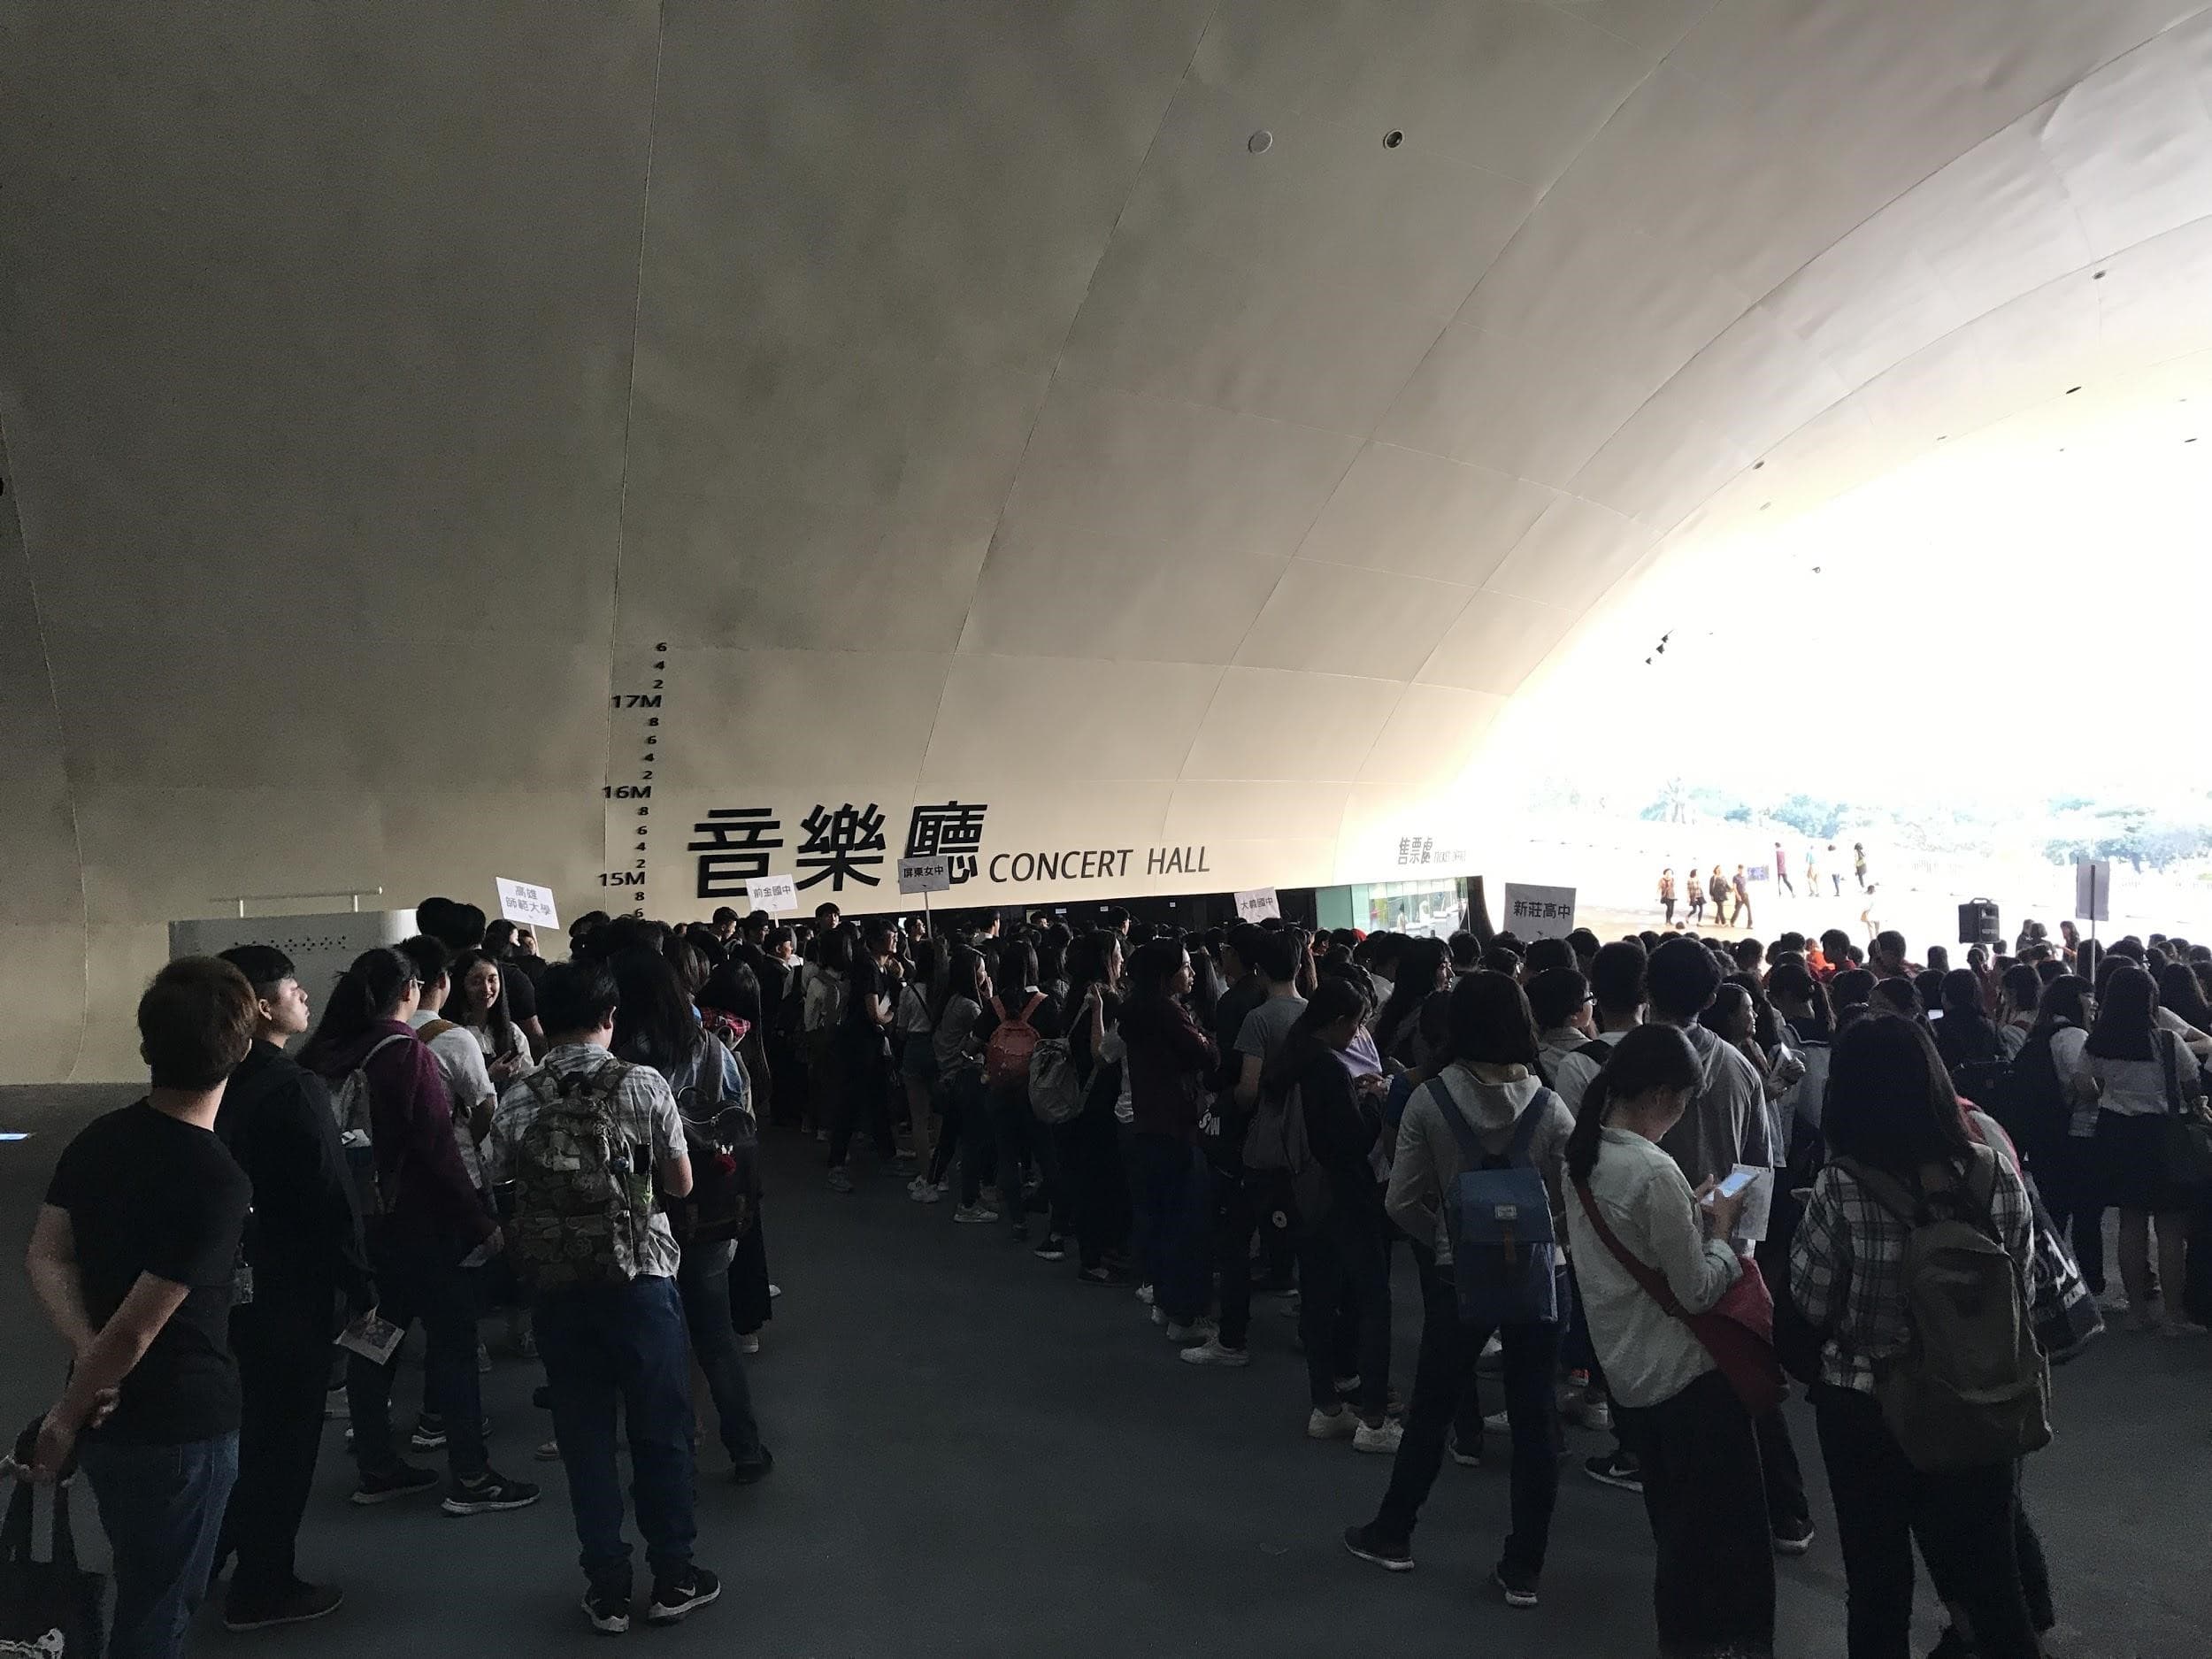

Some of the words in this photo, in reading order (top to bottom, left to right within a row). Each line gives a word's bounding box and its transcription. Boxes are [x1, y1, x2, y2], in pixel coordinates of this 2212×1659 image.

[655, 641, 667, 652] 6
[653, 660, 665, 671] 4
[652, 679, 664, 689] 2
[611, 695, 662, 709] 17M
[648, 717, 659, 727] 8
[646, 735, 657, 745] 6
[643, 753, 655, 763] 4
[641, 770, 653, 780] 2
[602, 785, 652, 799] 16M
[636, 806, 649, 816] 8
[635, 825, 648, 835] 6
[634, 841, 647, 851] 4
[688, 801, 988, 899] 音樂廳
[989, 849, 1134, 883] CONCERT
[1148, 846, 1210, 875] HALL
[1398, 836, 1433, 864] 售票處
[635, 858, 647, 869] 2
[903, 864, 944, 878] 屏東女中
[598, 872, 646, 887] 15M
[515, 886, 538, 900] 高雄
[634, 891, 646, 902] 8
[753, 884, 791, 898] 前金國中
[505, 896, 551, 916] 師範大學
[1513, 899, 1571, 920] 新莊高中
